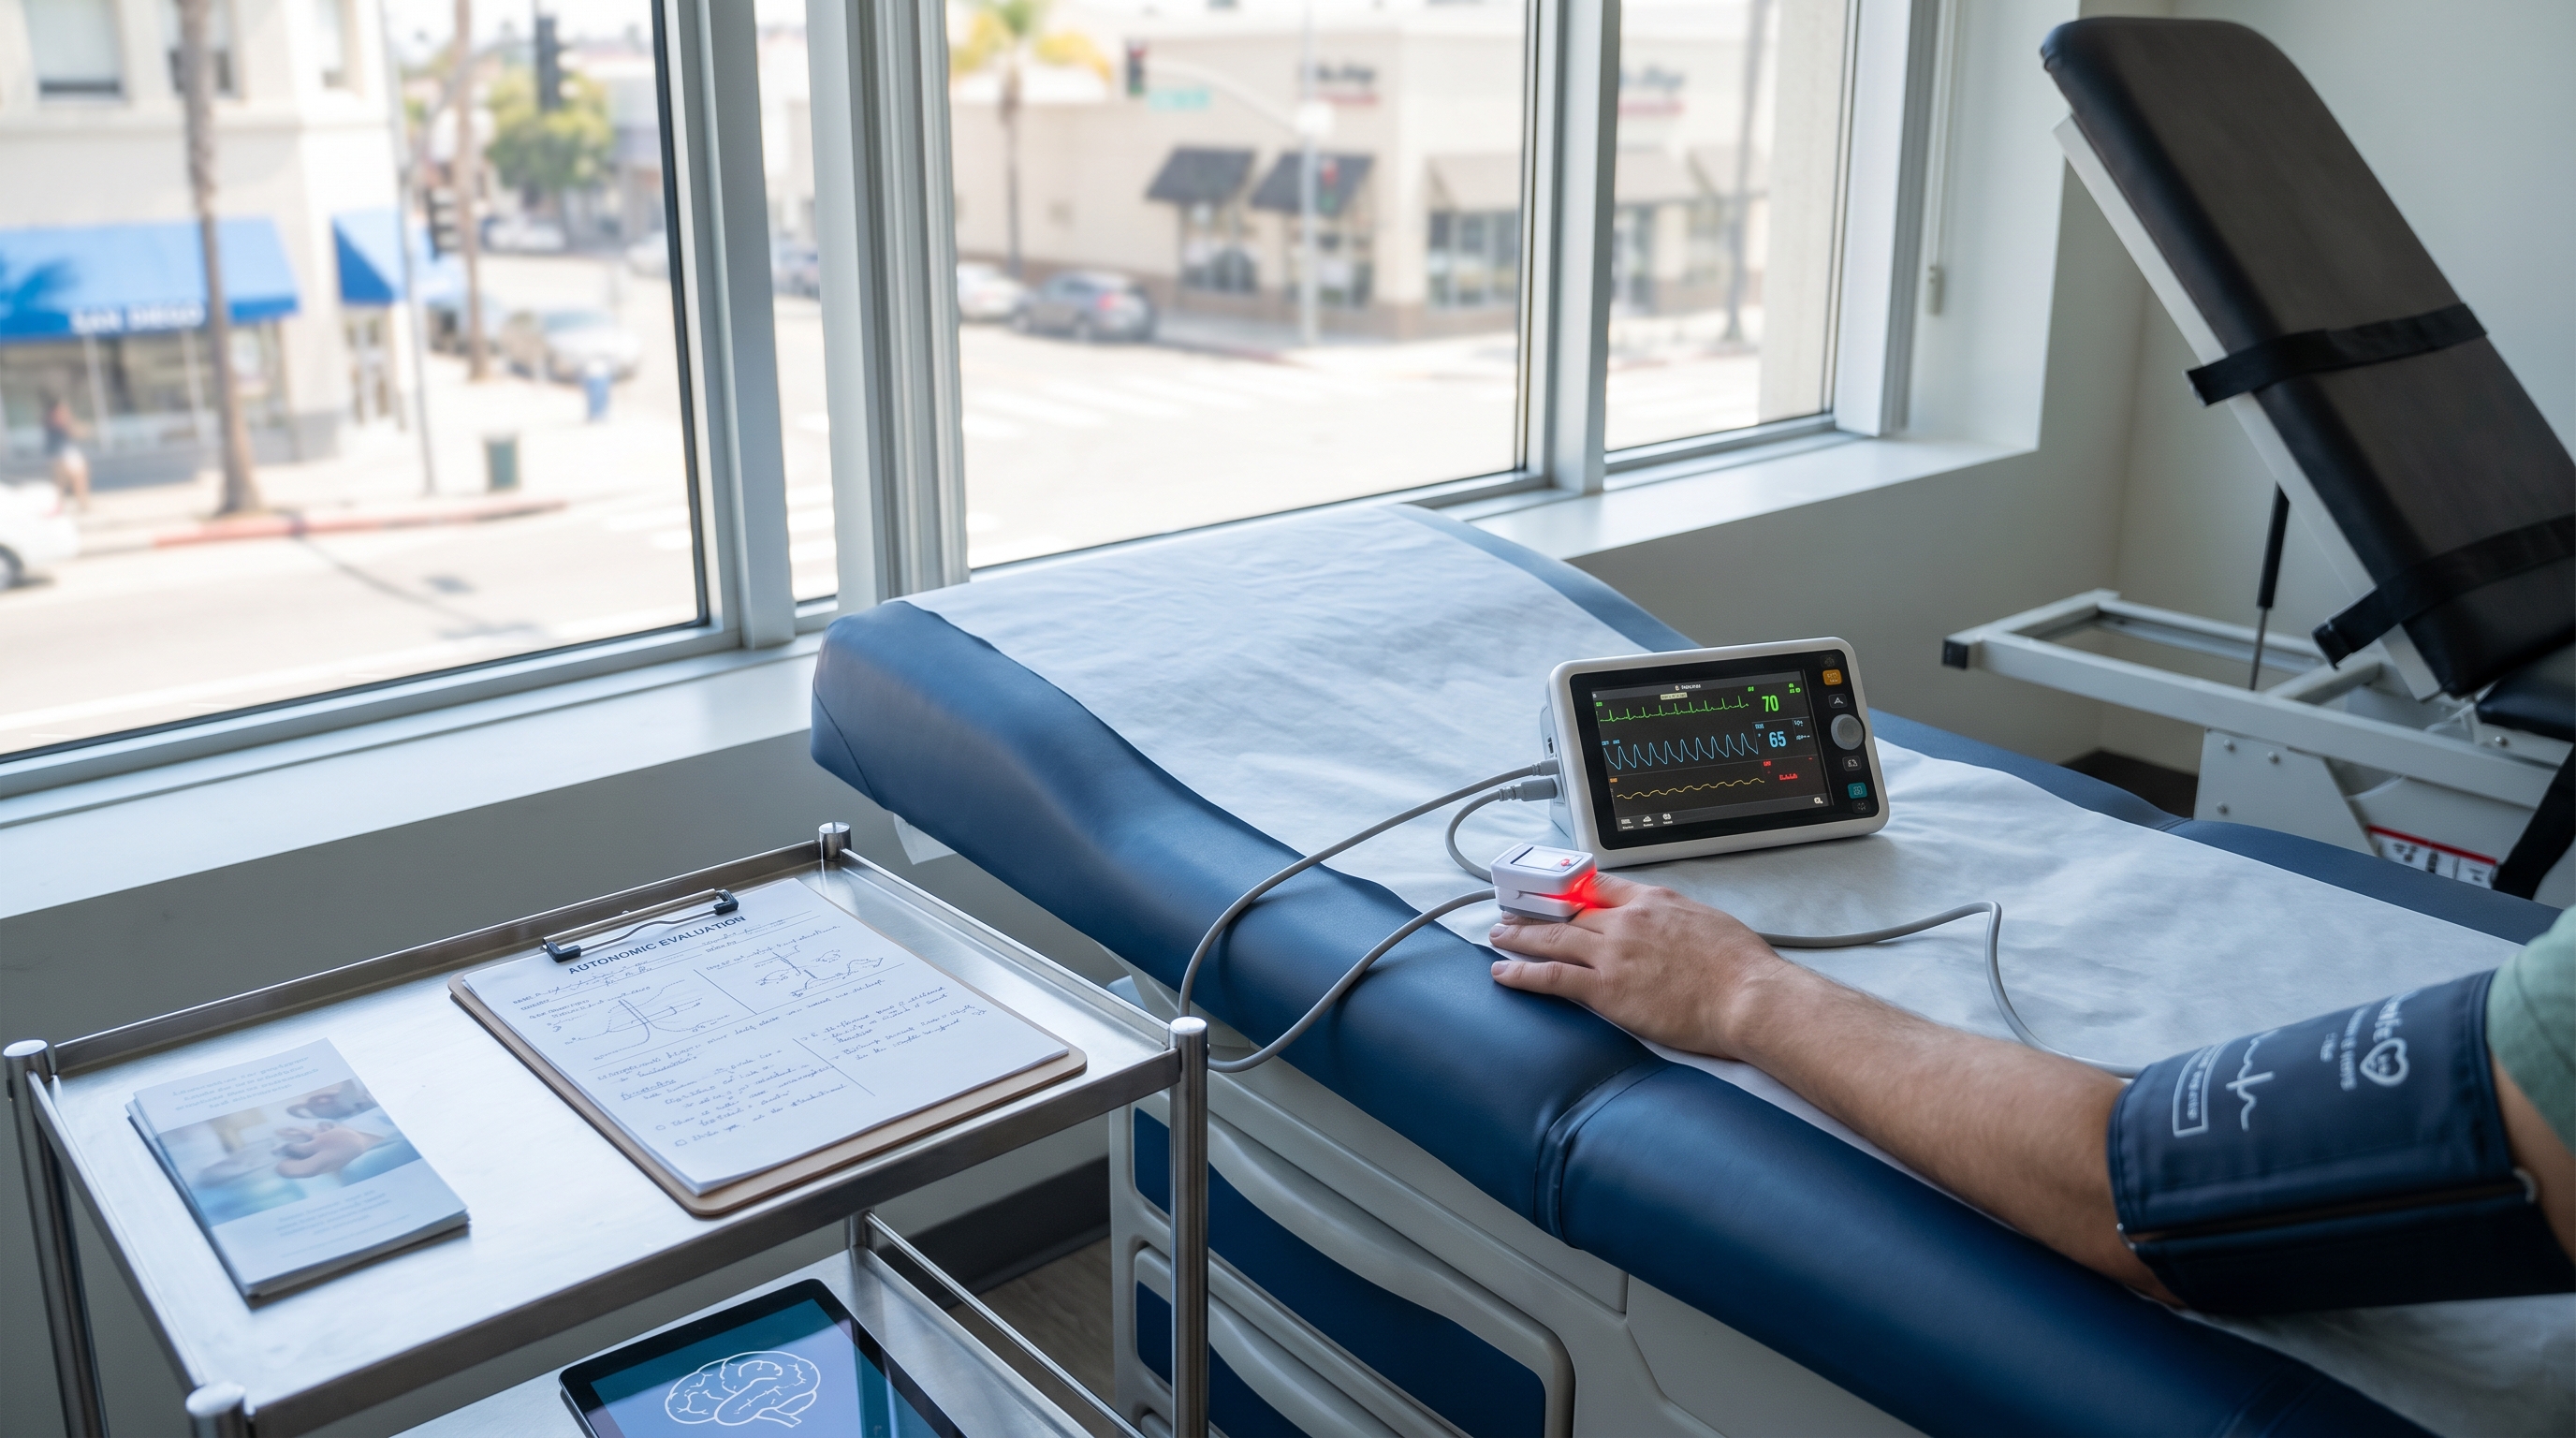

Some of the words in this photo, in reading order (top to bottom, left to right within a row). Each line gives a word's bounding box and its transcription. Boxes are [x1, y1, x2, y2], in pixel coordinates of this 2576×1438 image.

[72, 310, 123, 333] SAN
[127, 305, 204, 329] DIEGO
[1762, 695, 1779, 712] 70
[1768, 730, 1787, 748] 65
[568, 943, 657, 975] AUTONOMIC
[659, 916, 746, 946] EVALUATION
